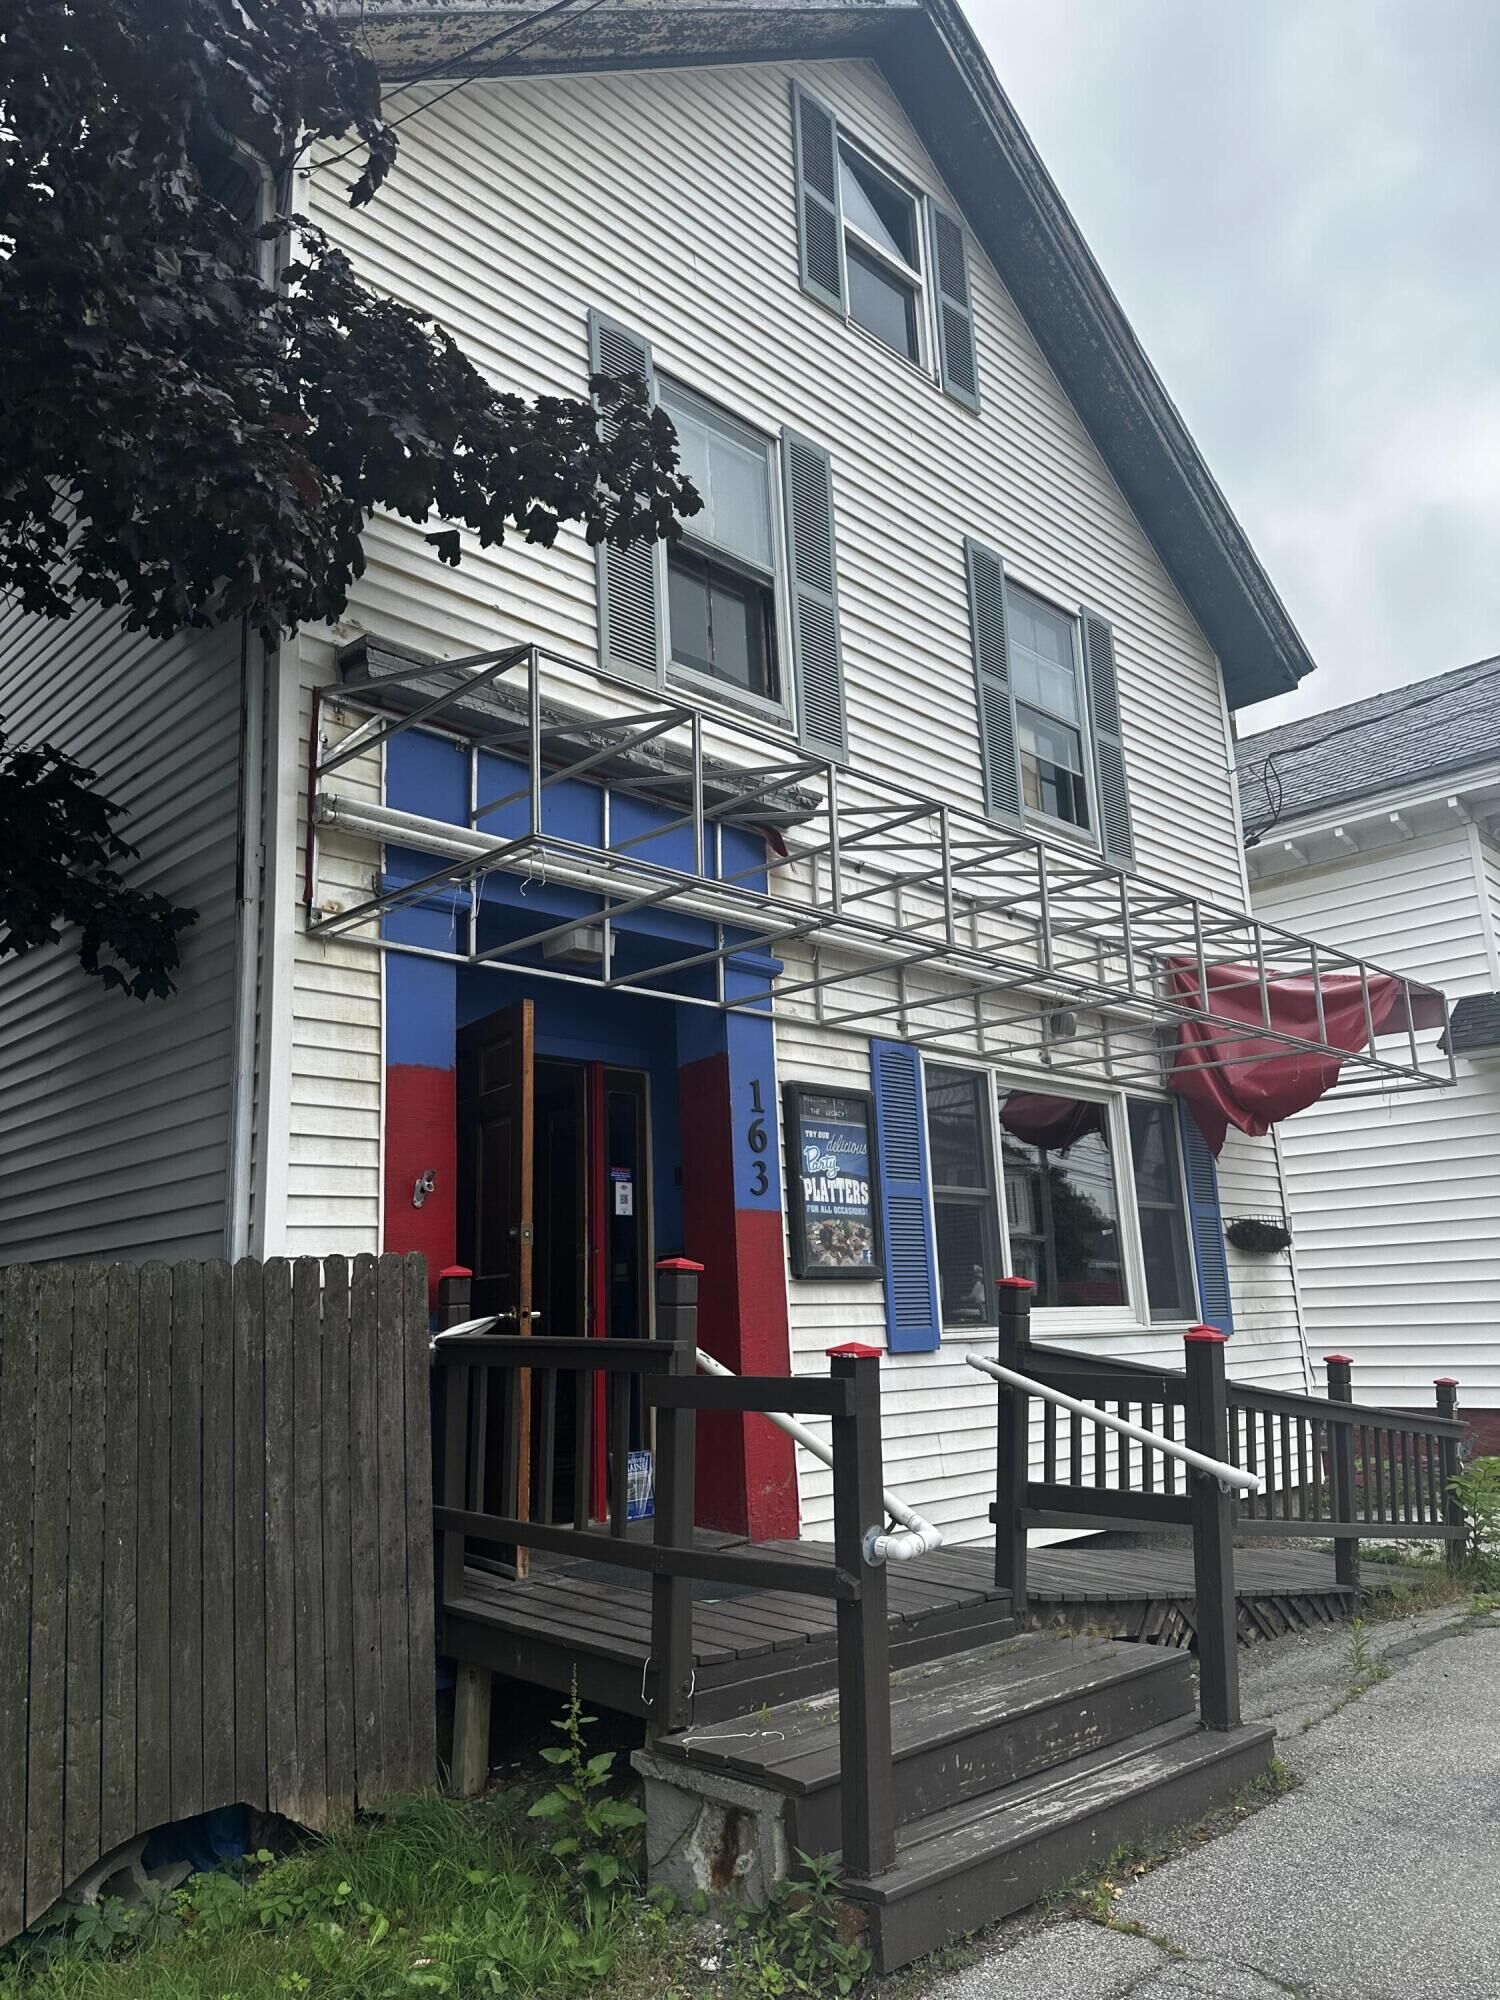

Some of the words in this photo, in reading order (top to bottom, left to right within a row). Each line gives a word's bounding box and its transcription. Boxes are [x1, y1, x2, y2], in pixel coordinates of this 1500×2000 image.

[748, 1079, 769, 1196] 163
[805, 1130, 817, 1138] TRY
[818, 1131, 830, 1139] OUR
[826, 1134, 867, 1155] delicious
[803, 1145, 840, 1179] Party
[803, 1176, 869, 1206] PLATTERS
[806, 1205, 819, 1213] FOR
[820, 1206, 833, 1214] ALL
